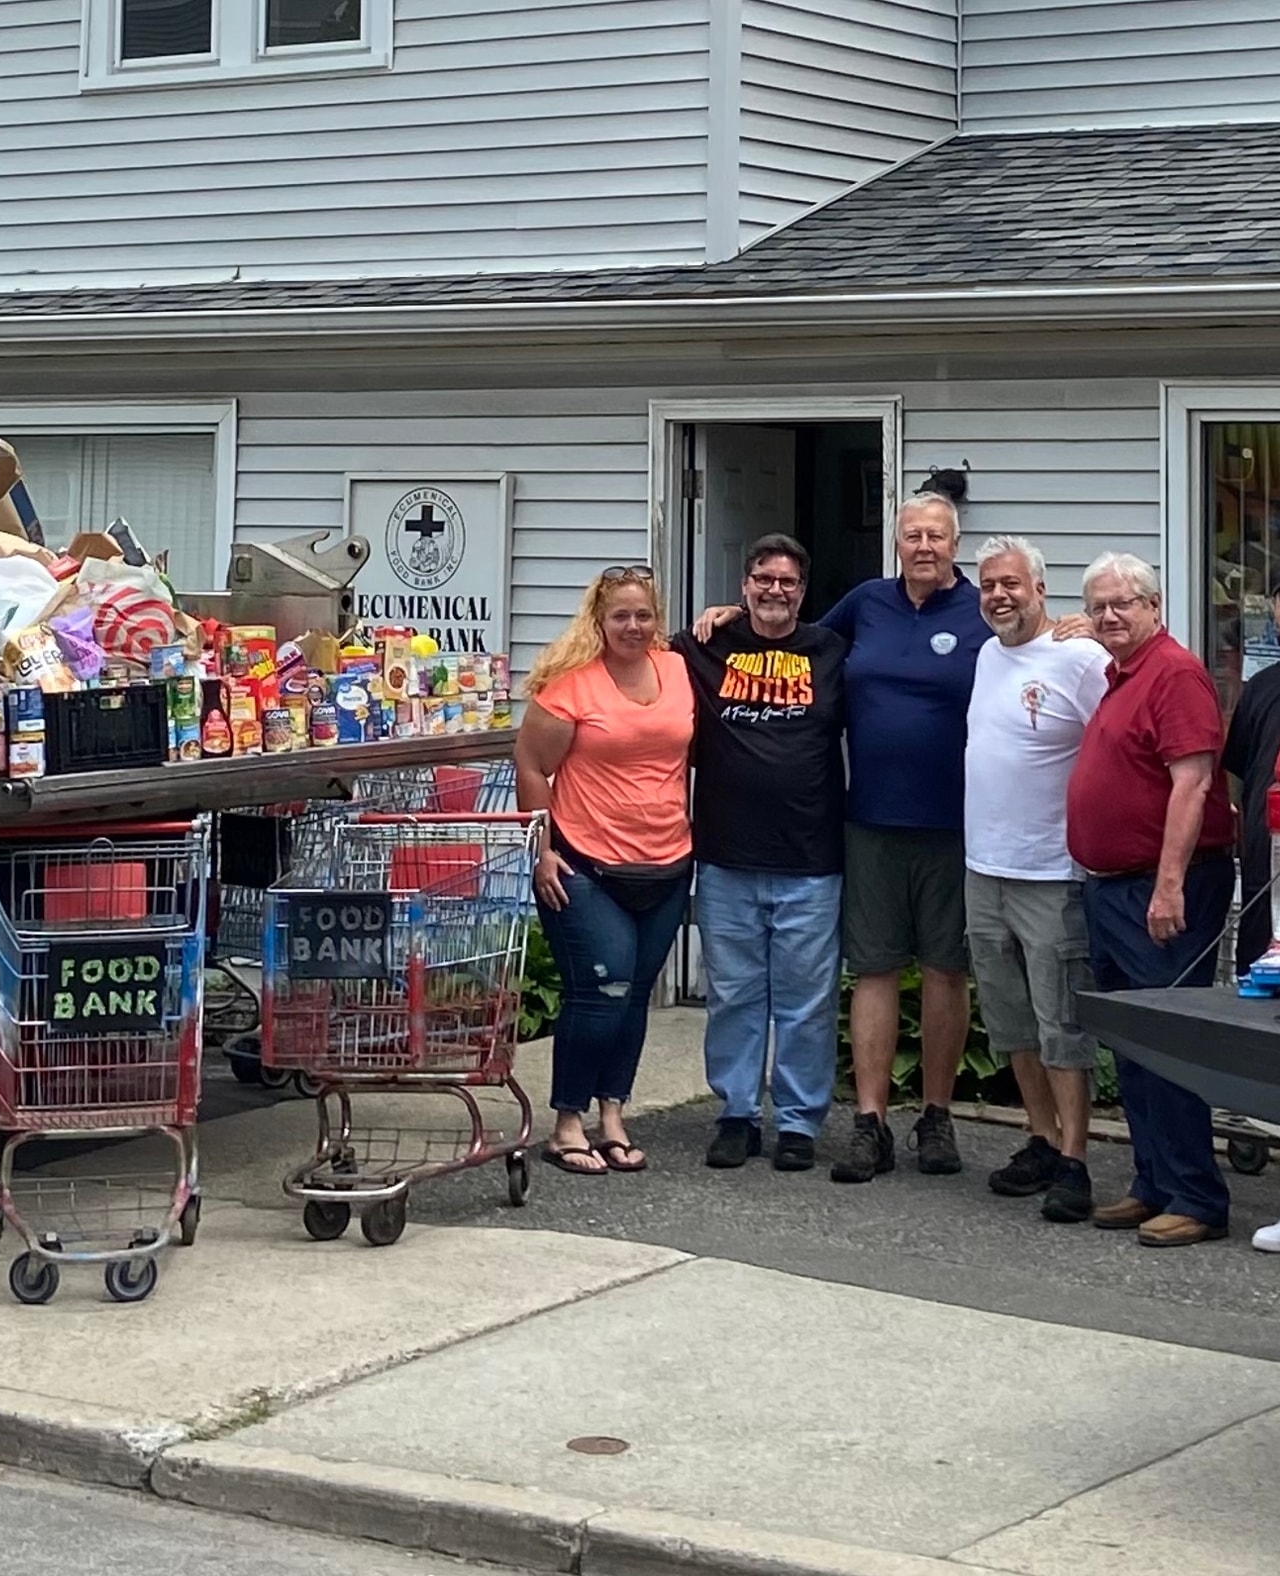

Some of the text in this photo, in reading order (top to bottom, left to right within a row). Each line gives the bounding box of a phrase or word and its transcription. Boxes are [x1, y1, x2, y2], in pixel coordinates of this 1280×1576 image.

[393, 490, 461, 521] ECUMENICAL
[358, 594, 492, 622] ECUMENICAL
[726, 650, 812, 679] FOOD TRUCK
[718, 667, 814, 706] BATTLES
[299, 905, 385, 931] FOOD
[291, 936, 383, 964] BANK
[61, 955, 160, 988] FOOD
[53, 990, 158, 1019] BANK
